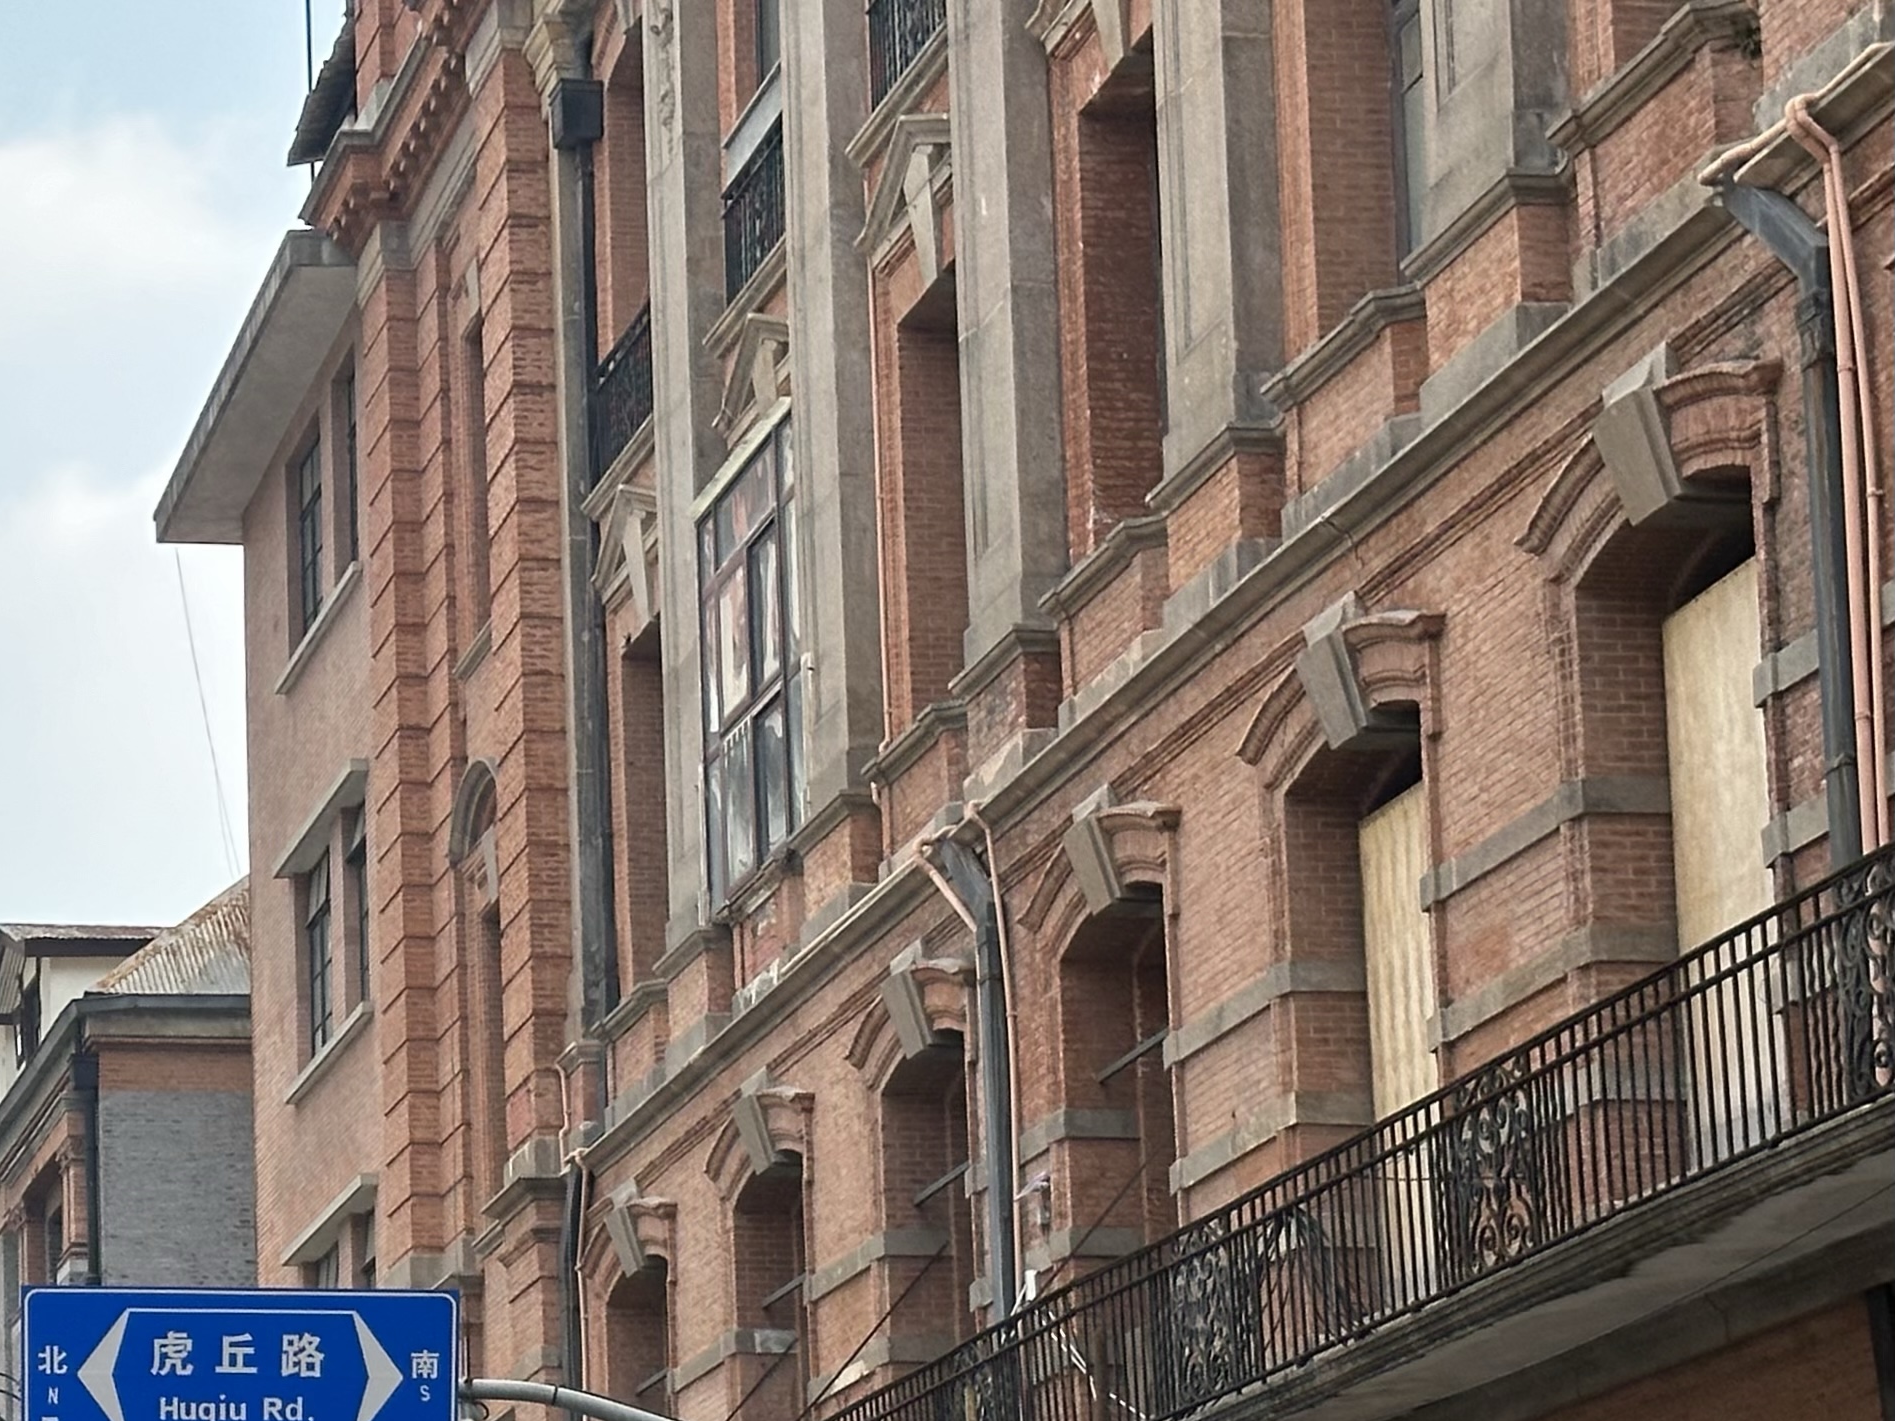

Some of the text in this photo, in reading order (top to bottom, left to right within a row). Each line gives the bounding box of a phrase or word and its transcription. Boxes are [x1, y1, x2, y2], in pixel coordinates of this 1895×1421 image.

[38, 1345, 68, 1375] 北
[150, 1331, 325, 1379] 虎丘路
[410, 1350, 439, 1379] 南
[48, 1387, 58, 1405] N
[420, 1385, 430, 1401] S
